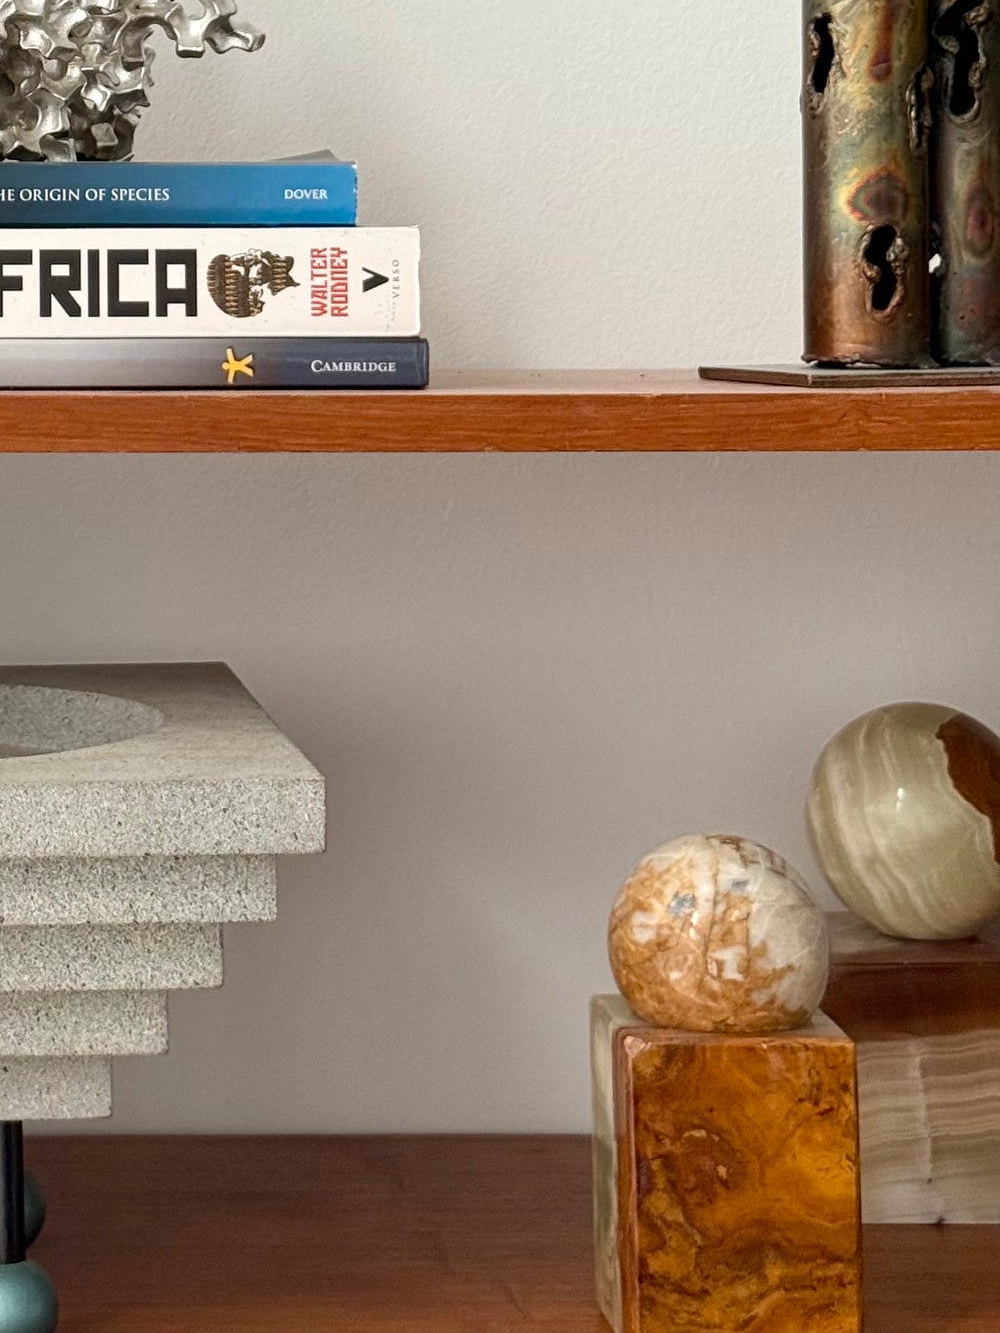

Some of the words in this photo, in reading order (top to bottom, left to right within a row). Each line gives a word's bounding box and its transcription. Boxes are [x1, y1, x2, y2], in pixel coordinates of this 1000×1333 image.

[19, 188, 80, 202] ORIGIN
[85, 188, 107, 201] OF
[110, 188, 170, 201] SPECIES
[284, 188, 328, 200] DOVER
[310, 247, 328, 317] WALTER
[330, 246, 348, 317] RODNEY
[392, 259, 400, 298] VERSO
[310, 359, 397, 372] CAMBRIDGE
